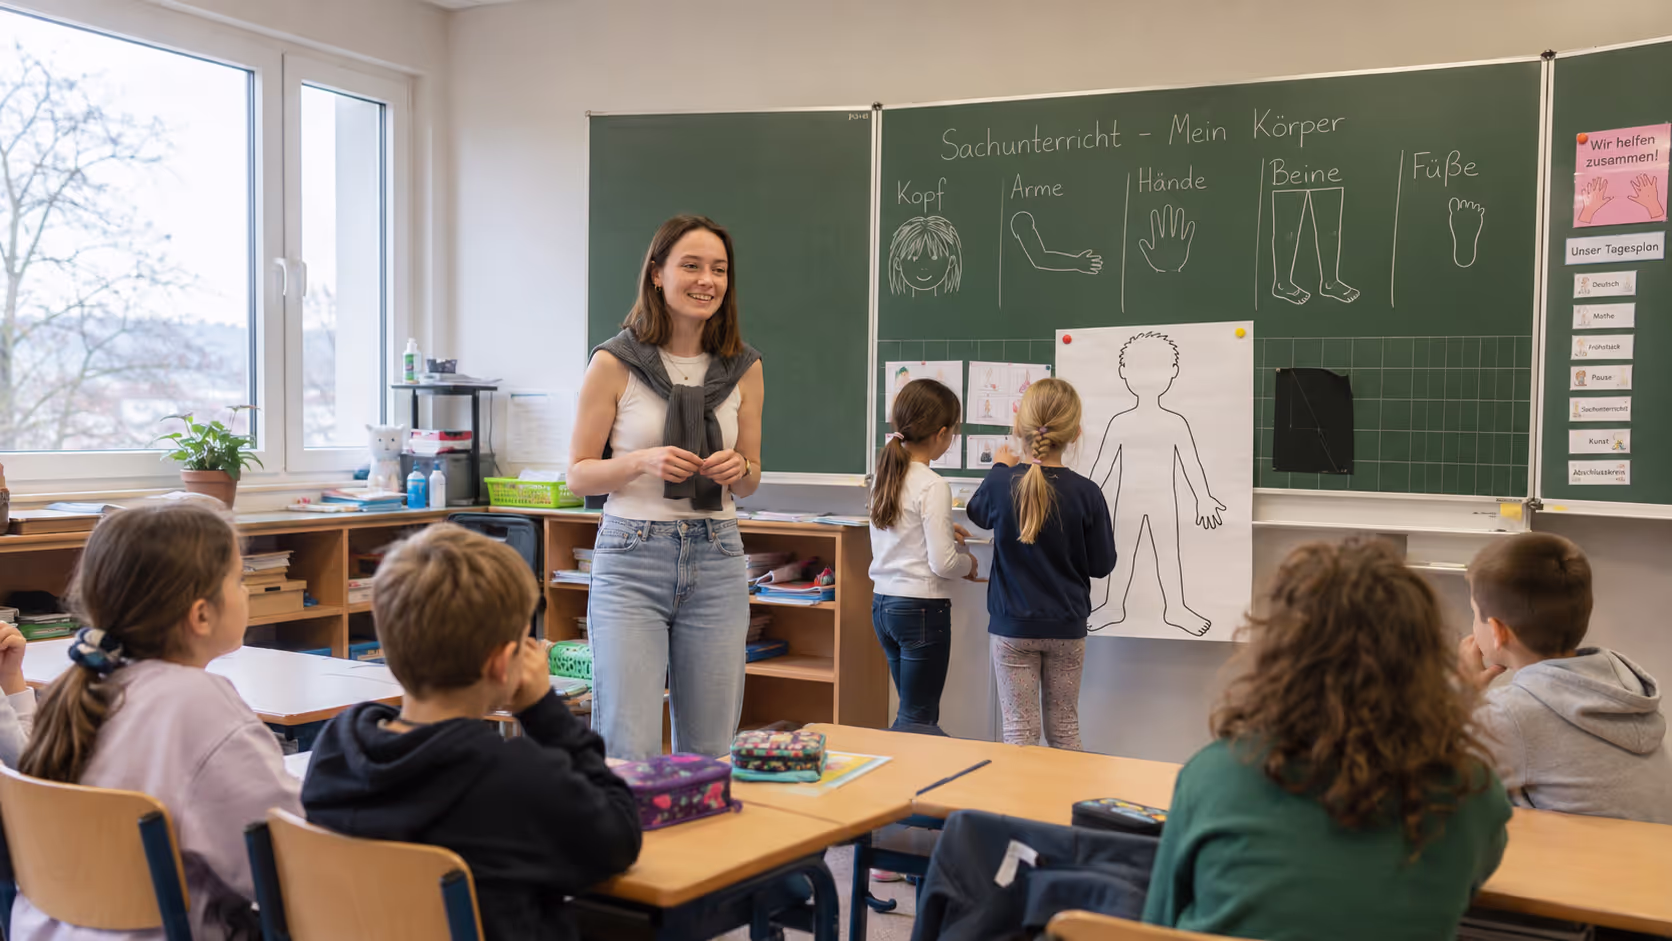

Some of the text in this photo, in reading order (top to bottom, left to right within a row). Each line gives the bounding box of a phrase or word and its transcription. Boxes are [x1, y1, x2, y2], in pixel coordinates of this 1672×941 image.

[940, 119, 1122, 161] Sachunterricht
[1168, 113, 1227, 145] Mein
[1253, 108, 1346, 147] Körper
[1590, 134, 1655, 151] Wir helfen
[1413, 150, 1479, 187] Füße
[1585, 149, 1659, 168] zusammen!
[1138, 165, 1207, 193] Hände
[1269, 158, 1343, 186] Beine
[897, 176, 947, 214] Kopf
[1010, 172, 1065, 200] Arme
[1571, 241, 1659, 257] Unser Tagesplan
[1592, 280, 1620, 288] Deutsch
[1592, 312, 1615, 320] Mathe
[1591, 373, 1613, 381] Pause
